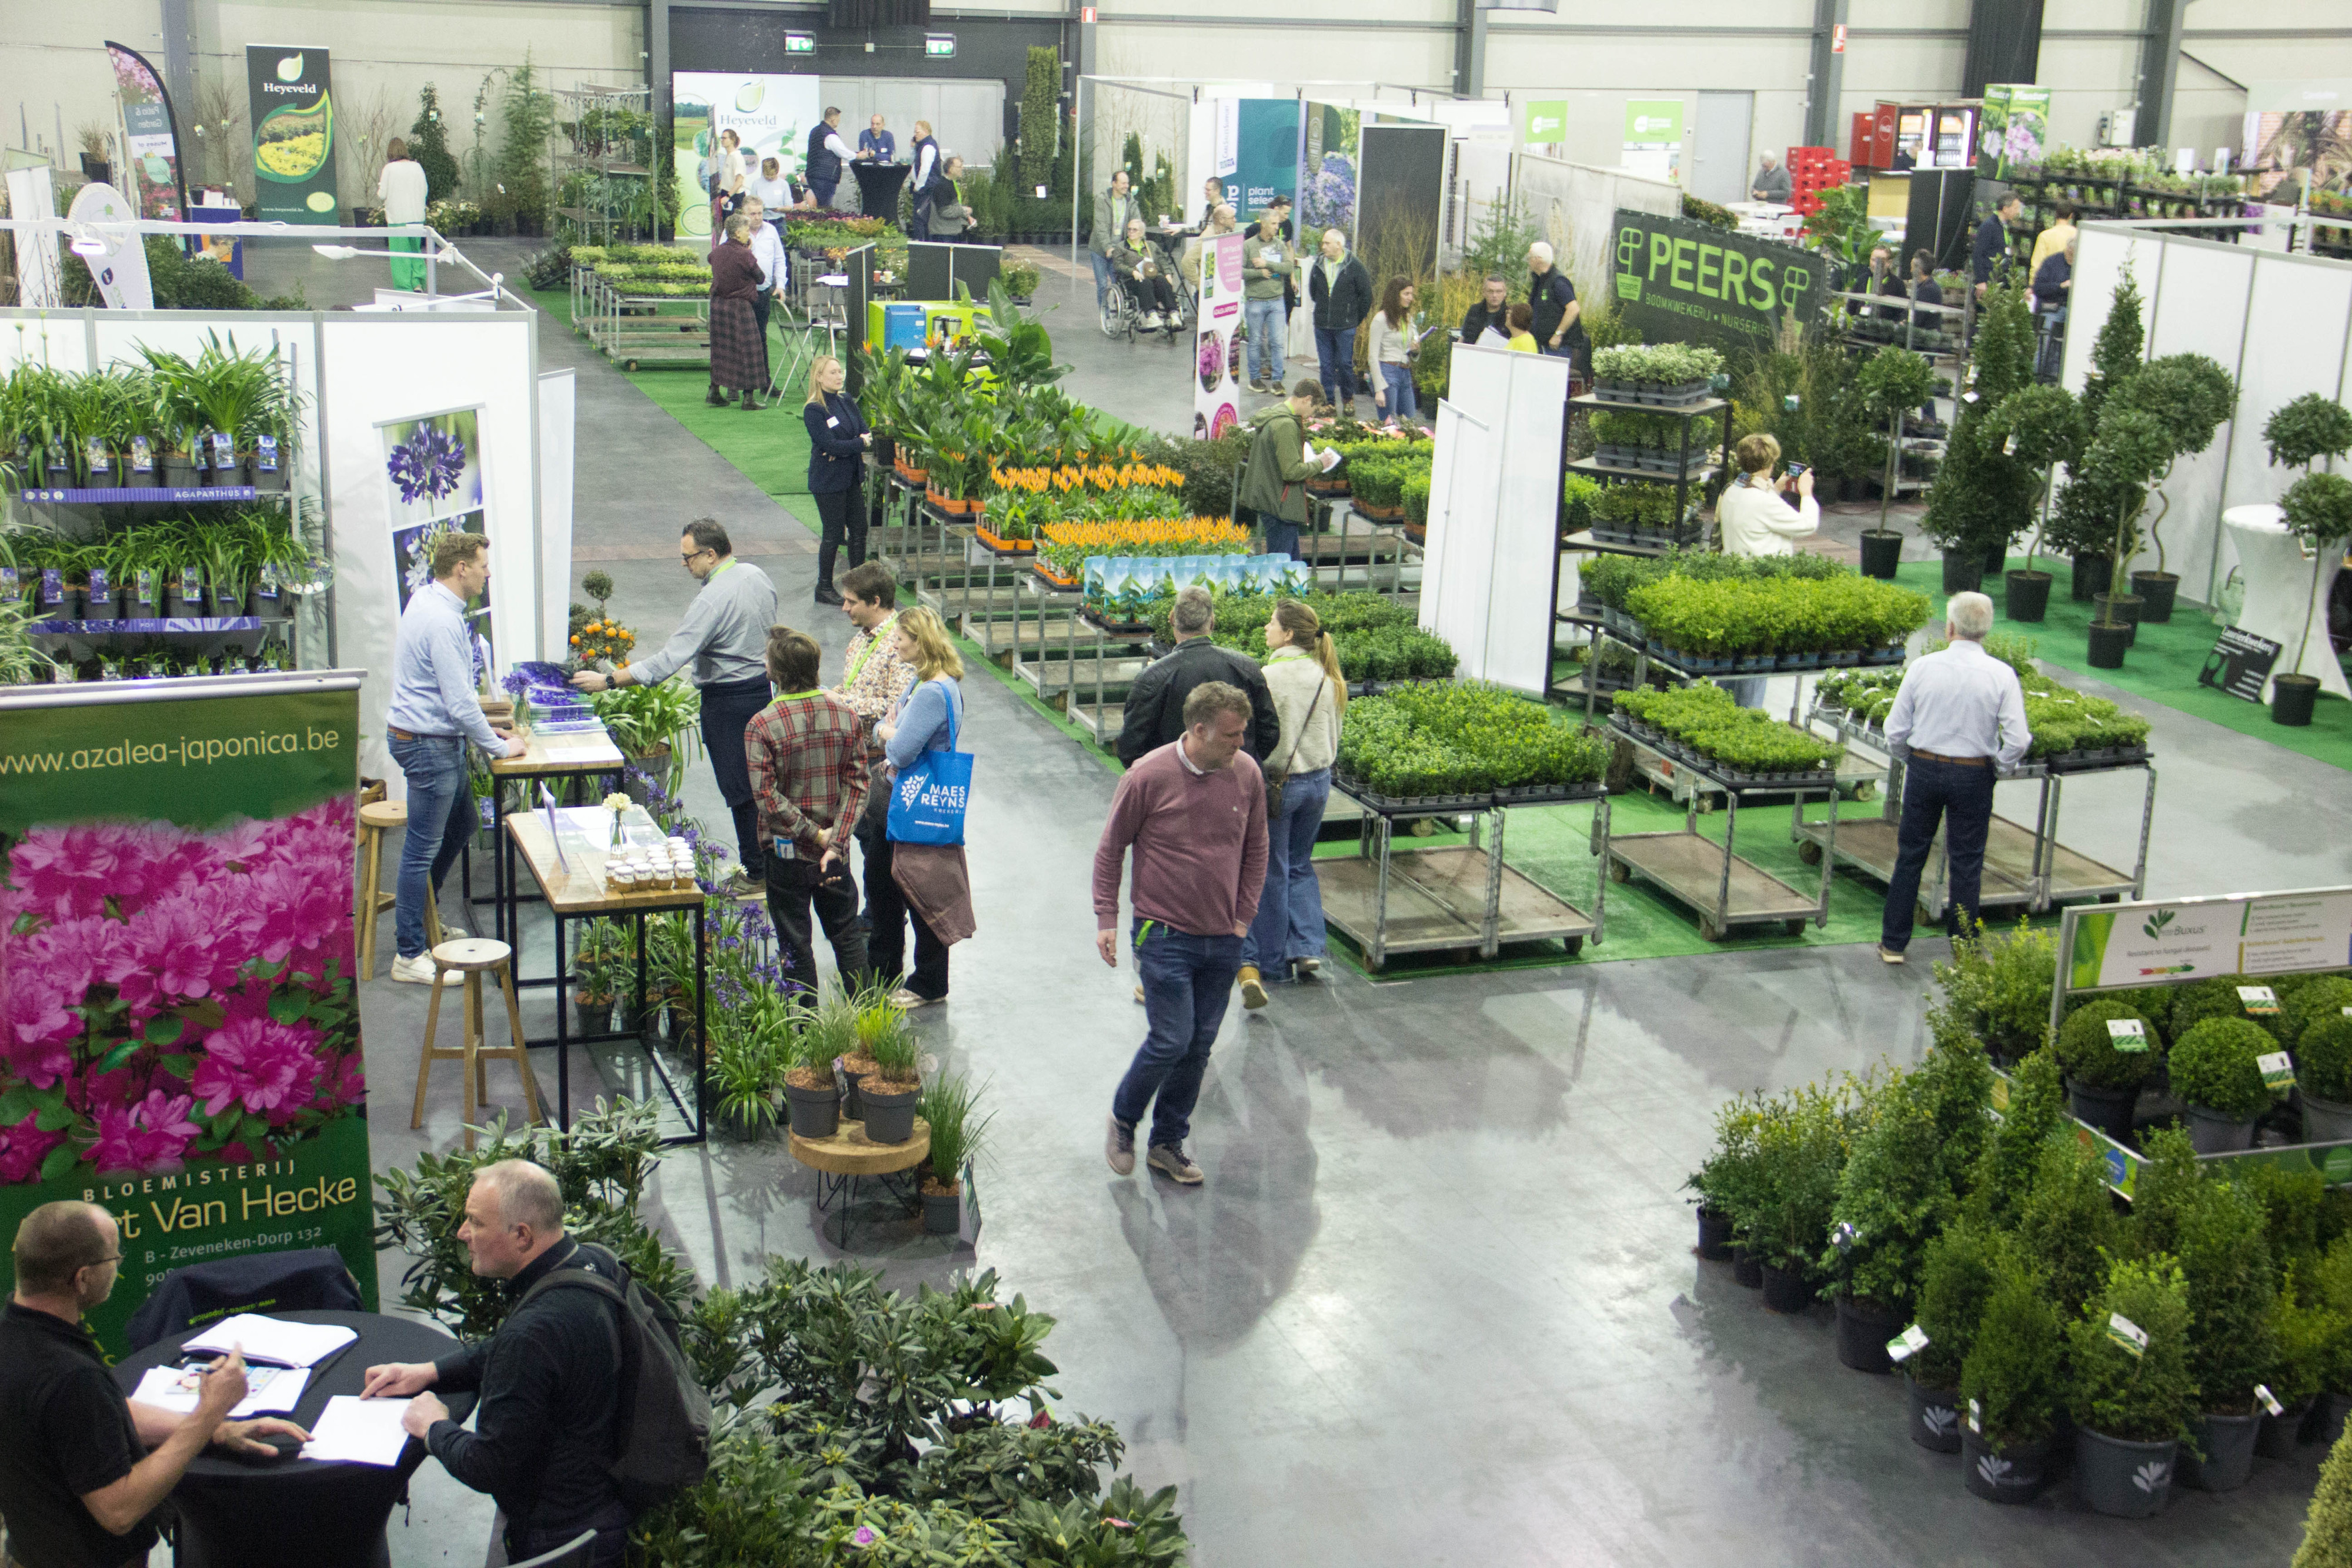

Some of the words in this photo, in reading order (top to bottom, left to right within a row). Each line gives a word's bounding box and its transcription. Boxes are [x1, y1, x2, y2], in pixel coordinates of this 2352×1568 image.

[263, 83, 316, 95] Heyeveld
[720, 115, 777, 128] Heyeveld
[1248, 186, 1274, 197] plant
[1248, 196, 1274, 205] selec
[1648, 232, 1776, 311] PEERS
[1645, 293, 1710, 322] BOOMKWEKERIJ
[1721, 313, 1770, 339] NURSERIES
[175, 489, 240, 499] AGAPANTHUS
[930, 783, 965, 797] MAES
[921, 793, 965, 808] REYNS
[83, 1159, 295, 1202] BLOEMISTERIJ
[151, 1196, 226, 1233] Van
[241, 1175, 357, 1221] Hecke
[145, 1251, 155, 1264] B
[170, 1232, 293, 1260] Zeveneken-Dorp
[297, 1227, 322, 1241] 132
